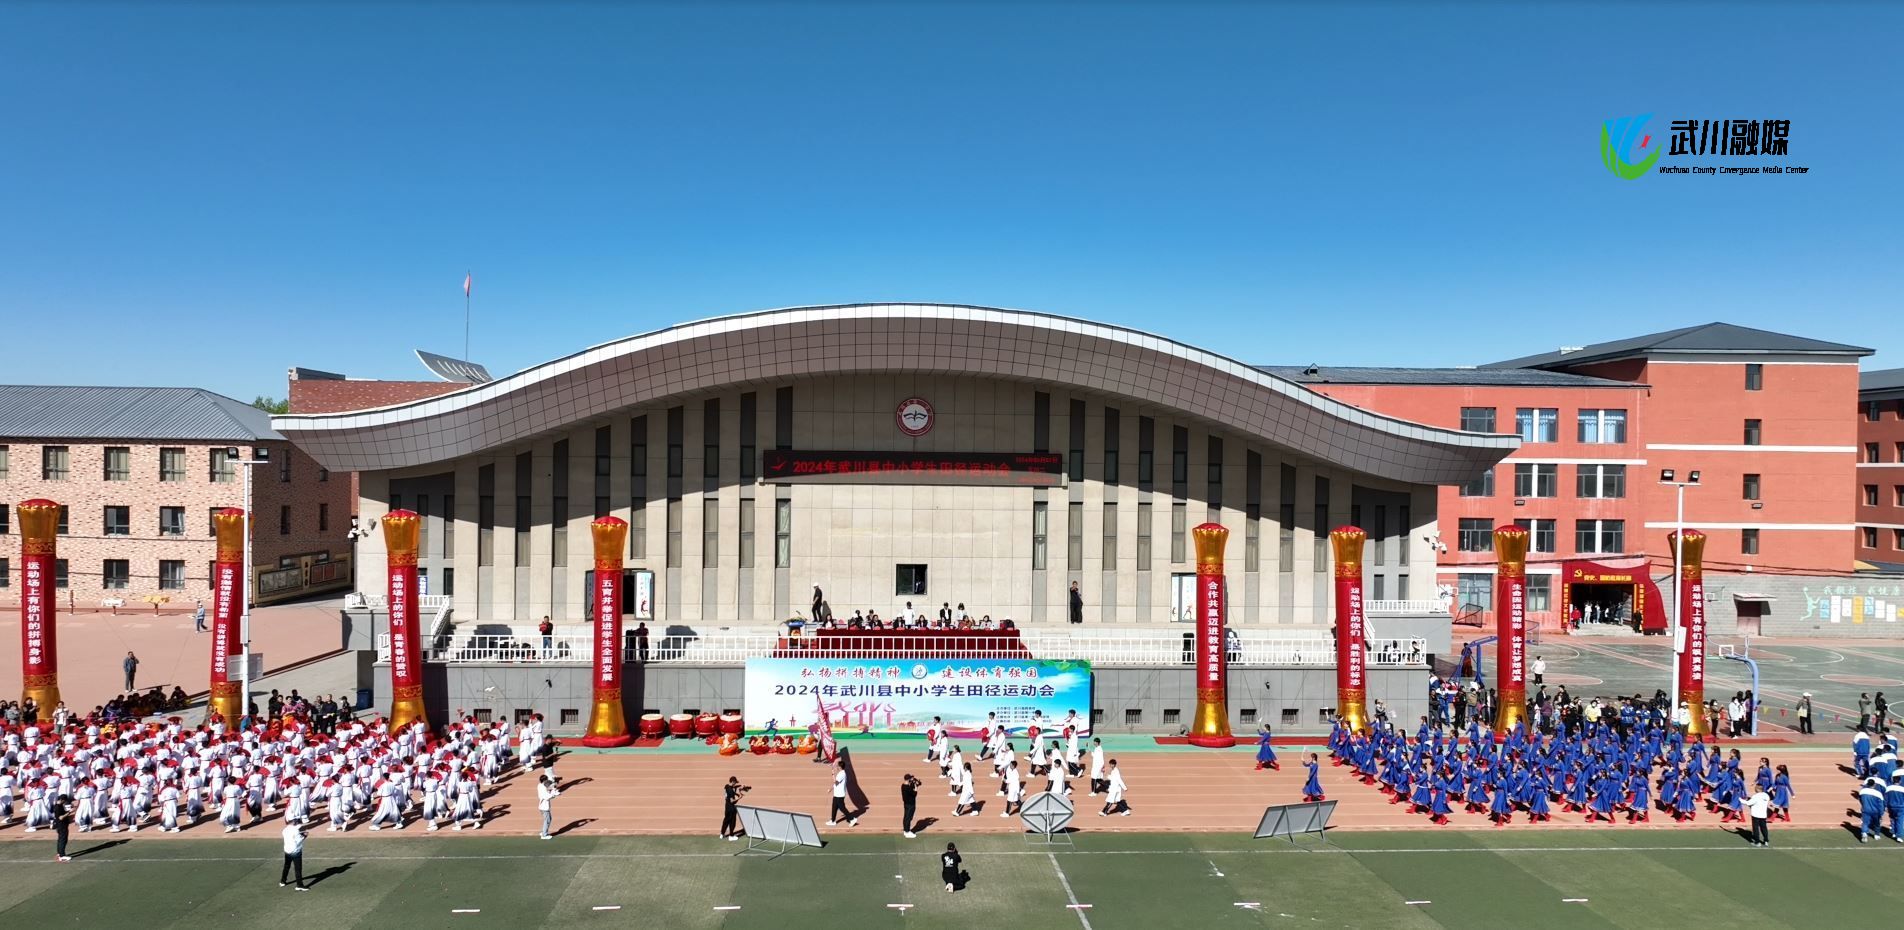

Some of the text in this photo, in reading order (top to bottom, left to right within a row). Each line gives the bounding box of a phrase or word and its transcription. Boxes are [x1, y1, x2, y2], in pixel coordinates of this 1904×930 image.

[792, 460, 1010, 476] 2024年武川县中小学生田径运动会
[26, 561, 42, 665] 运动场上有你们的拼搏身影
[391, 574, 405, 626] 运动场上的你们
[1350, 587, 1361, 637] 运动场上的你们
[601, 579, 614, 682] 五育并举促进学生全面发展
[1207, 581, 1219, 681] 合作共赢迈进教育高质量
[774, 683, 1055, 698] 2024年武川县中小学生田径运动会
[800, 666, 1038, 680] 弘扬拼搏精神 建设体育强国
